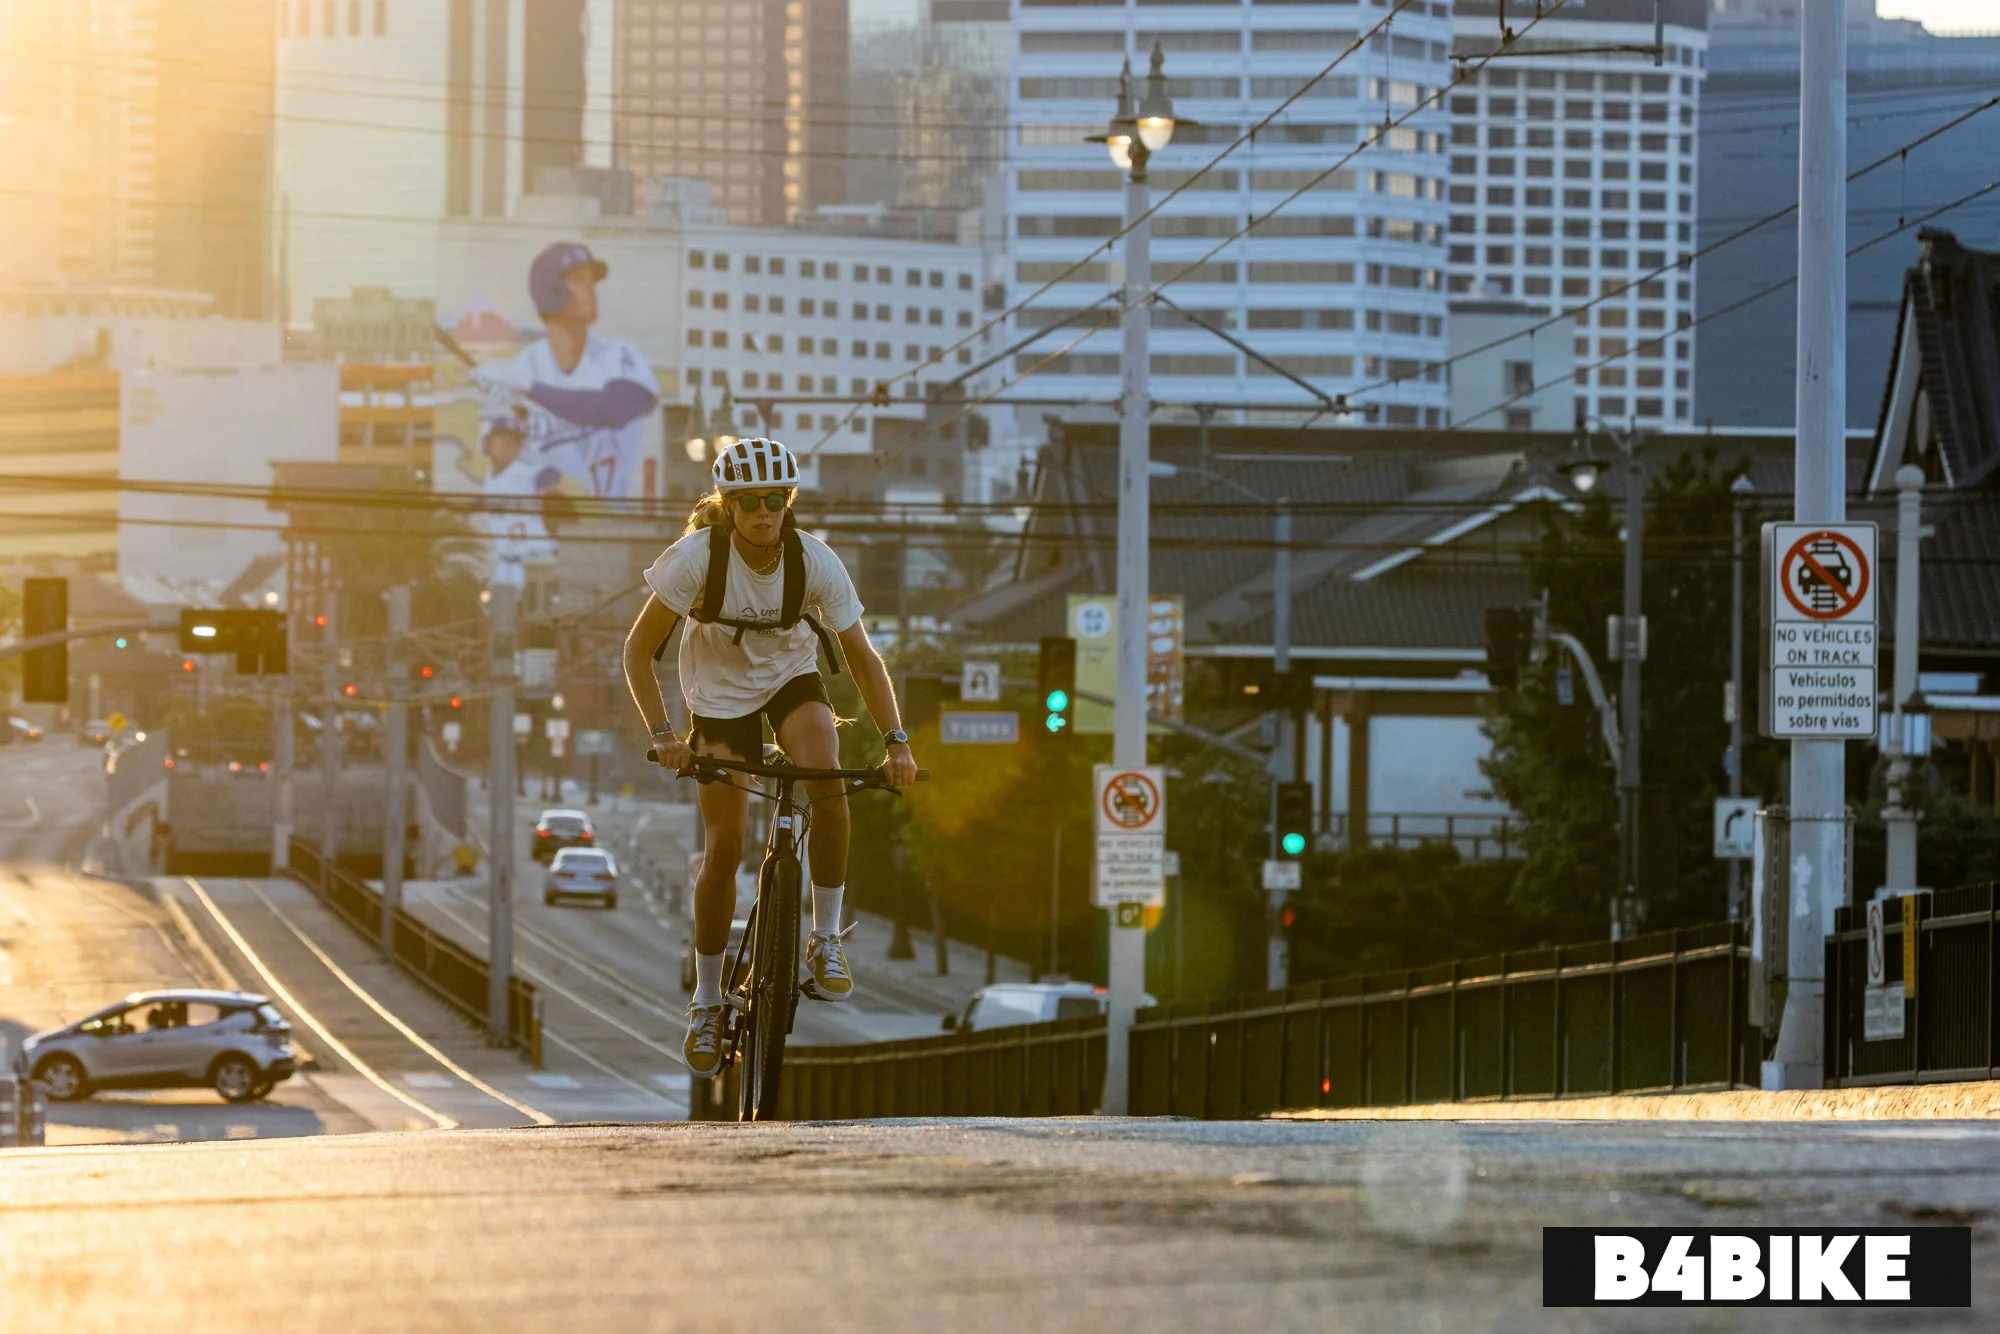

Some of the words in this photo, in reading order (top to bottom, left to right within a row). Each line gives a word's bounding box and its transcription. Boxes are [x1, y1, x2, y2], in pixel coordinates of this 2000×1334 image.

[1777, 629, 1797, 643] NO
[1803, 629, 1872, 644] VEHICLES
[1787, 649, 1807, 663] ON
[1814, 649, 1861, 664] TRACK
[1777, 695, 1794, 707] no
[1798, 692, 1872, 710] permitidos
[1788, 714, 1828, 729] sobre
